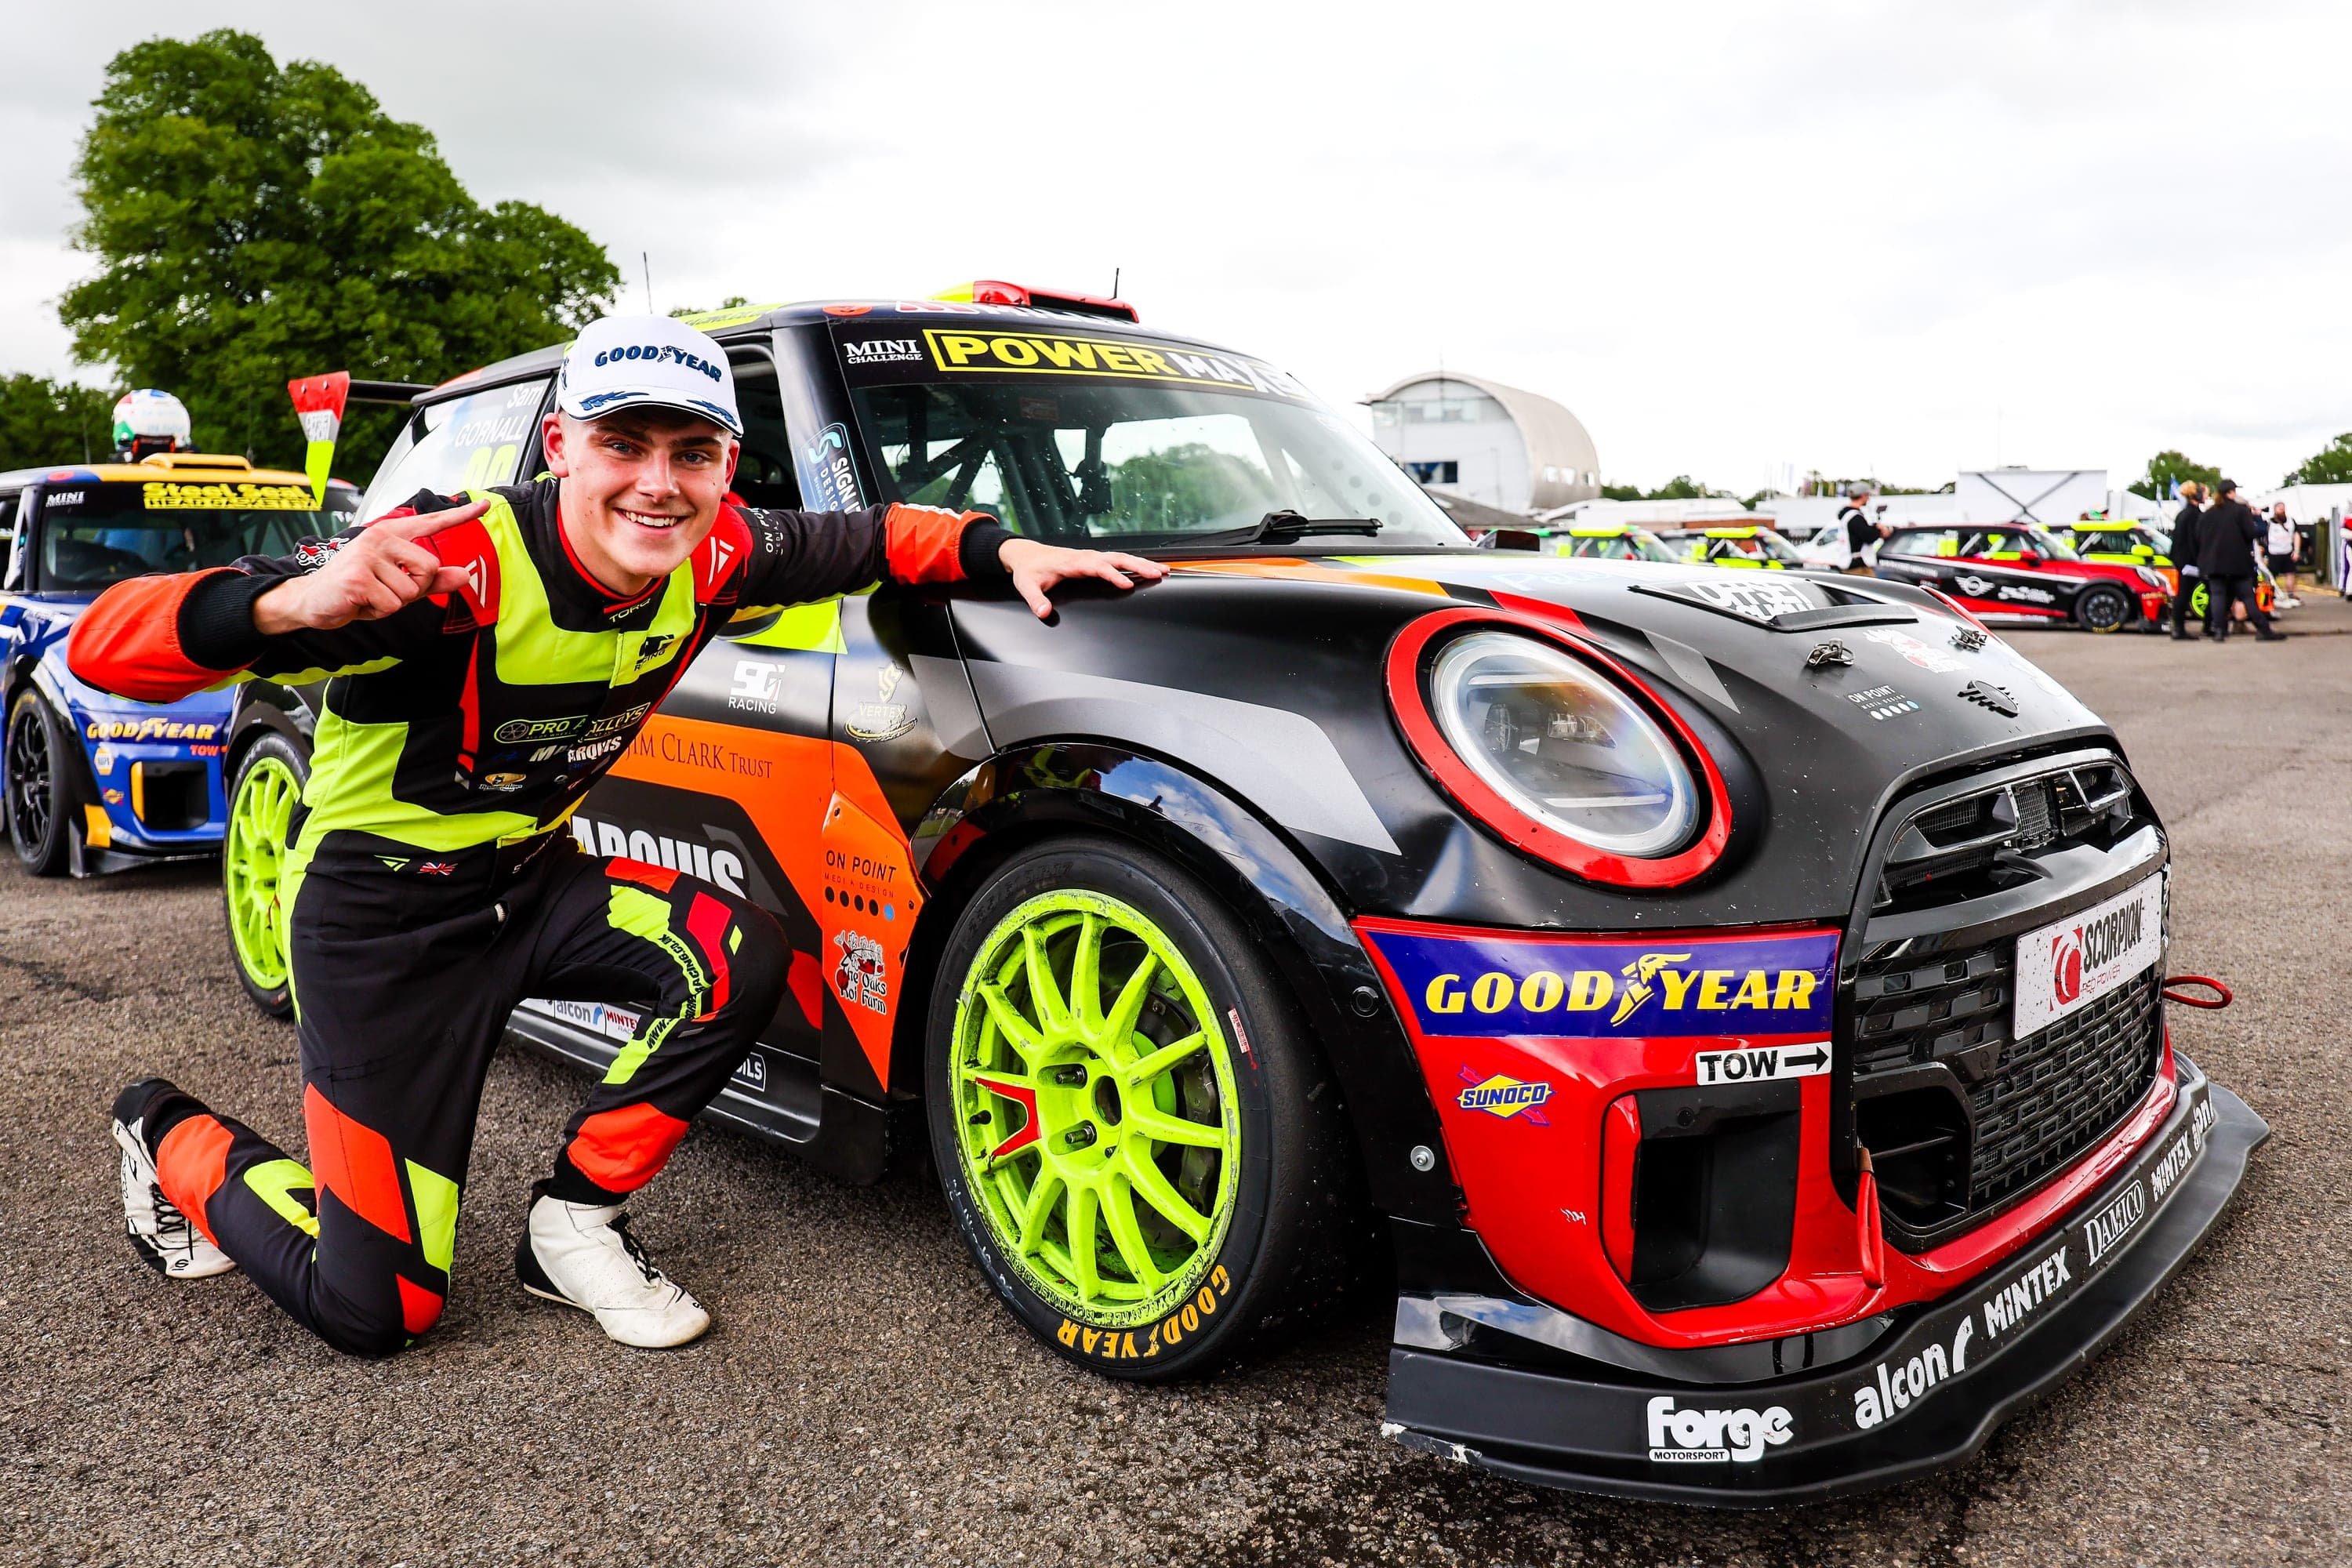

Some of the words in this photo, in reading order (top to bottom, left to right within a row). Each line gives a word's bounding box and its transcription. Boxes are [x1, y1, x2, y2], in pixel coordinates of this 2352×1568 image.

[844, 339, 920, 358] MINI
[848, 353, 924, 365] CHALLENGE
[595, 345, 722, 383] GOODYEAR
[507, 383, 544, 408] Sam
[455, 415, 528, 447] GORNALL
[820, 466, 839, 512] DESIG
[832, 457, 856, 505] SIGN
[728, 696, 777, 715] RACING
[1848, 691, 1868, 704] ON
[1864, 684, 1896, 700] POINT
[859, 704, 906, 719] VERTEX
[86, 719, 216, 741] GOODYEAR
[528, 720, 570, 735] PRO
[190, 745, 220, 757] TOW
[662, 732, 725, 771] CLARK
[729, 752, 774, 779] TRUST
[826, 850, 846, 870] ON
[852, 856, 897, 883] POINT
[859, 883, 895, 898] DESIGN
[2084, 898, 2143, 973] SCORPION
[862, 973, 886, 995] Oaks
[2097, 964, 2121, 985] POWER
[862, 989, 887, 1014] Farm
[1425, 967, 1817, 1014] GOODYEAR
[557, 1000, 591, 1022] alcon
[606, 1009, 639, 1029] MINTE
[1699, 1051, 1778, 1082] TOW
[1460, 1086, 1548, 1109] SUNOCO
[2151, 1131, 2193, 1202] MINTEX
[2084, 1183, 2143, 1267] DAMICO
[1983, 1245, 2071, 1340] MINTEX
[1055, 1263, 1231, 1360] GOODYEAR
[1855, 1343, 1949, 1429] alcon
[1647, 1396, 1795, 1462] forge
[1653, 1450, 1726, 1461] MOTORSPORT
